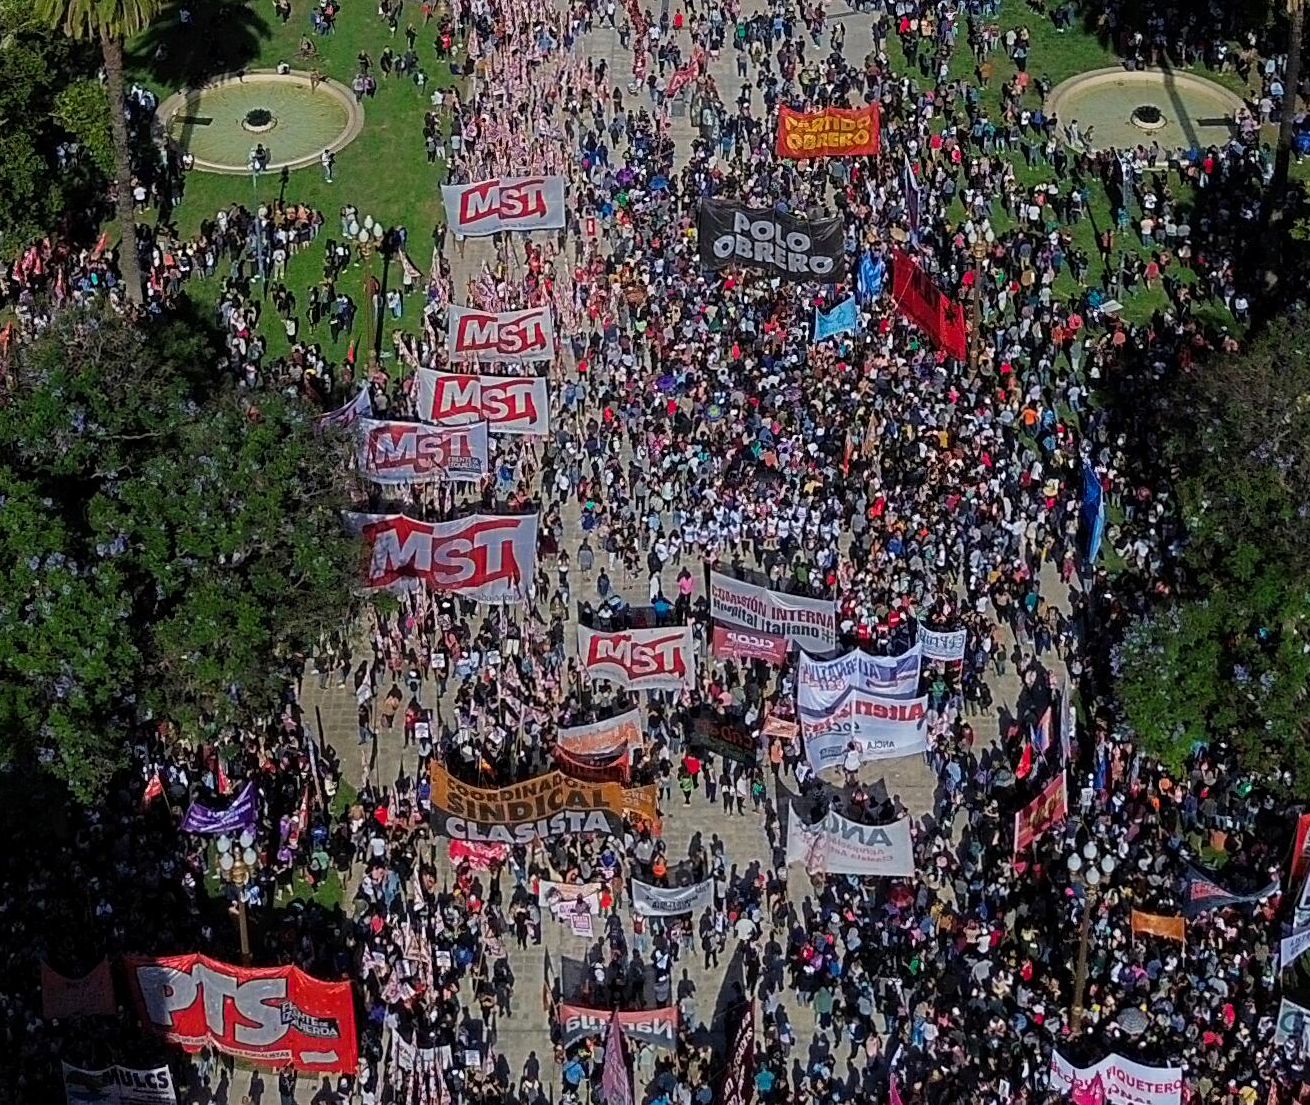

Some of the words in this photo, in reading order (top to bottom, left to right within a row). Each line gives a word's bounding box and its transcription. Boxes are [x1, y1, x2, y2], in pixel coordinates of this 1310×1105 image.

[785, 114, 870, 132] PARTIDO
[786, 129, 870, 150] OBRERO
[466, 185, 545, 218] MST
[734, 211, 810, 252] POLO
[713, 234, 833, 274] OBRERO
[462, 318, 541, 352] MST
[440, 380, 535, 420] MST
[375, 432, 471, 468] MST
[369, 527, 517, 584] MST
[761, 619, 819, 638] Italiano
[771, 606, 834, 630] INTERNA
[596, 638, 681, 673] MST
[447, 789, 610, 822] SINDICAL
[446, 810, 612, 844] CLASISTA
[136, 963, 288, 1046] PTS
[103, 1068, 169, 1089] MULCS
[1106, 1066, 1182, 1093] PIQUETERO
